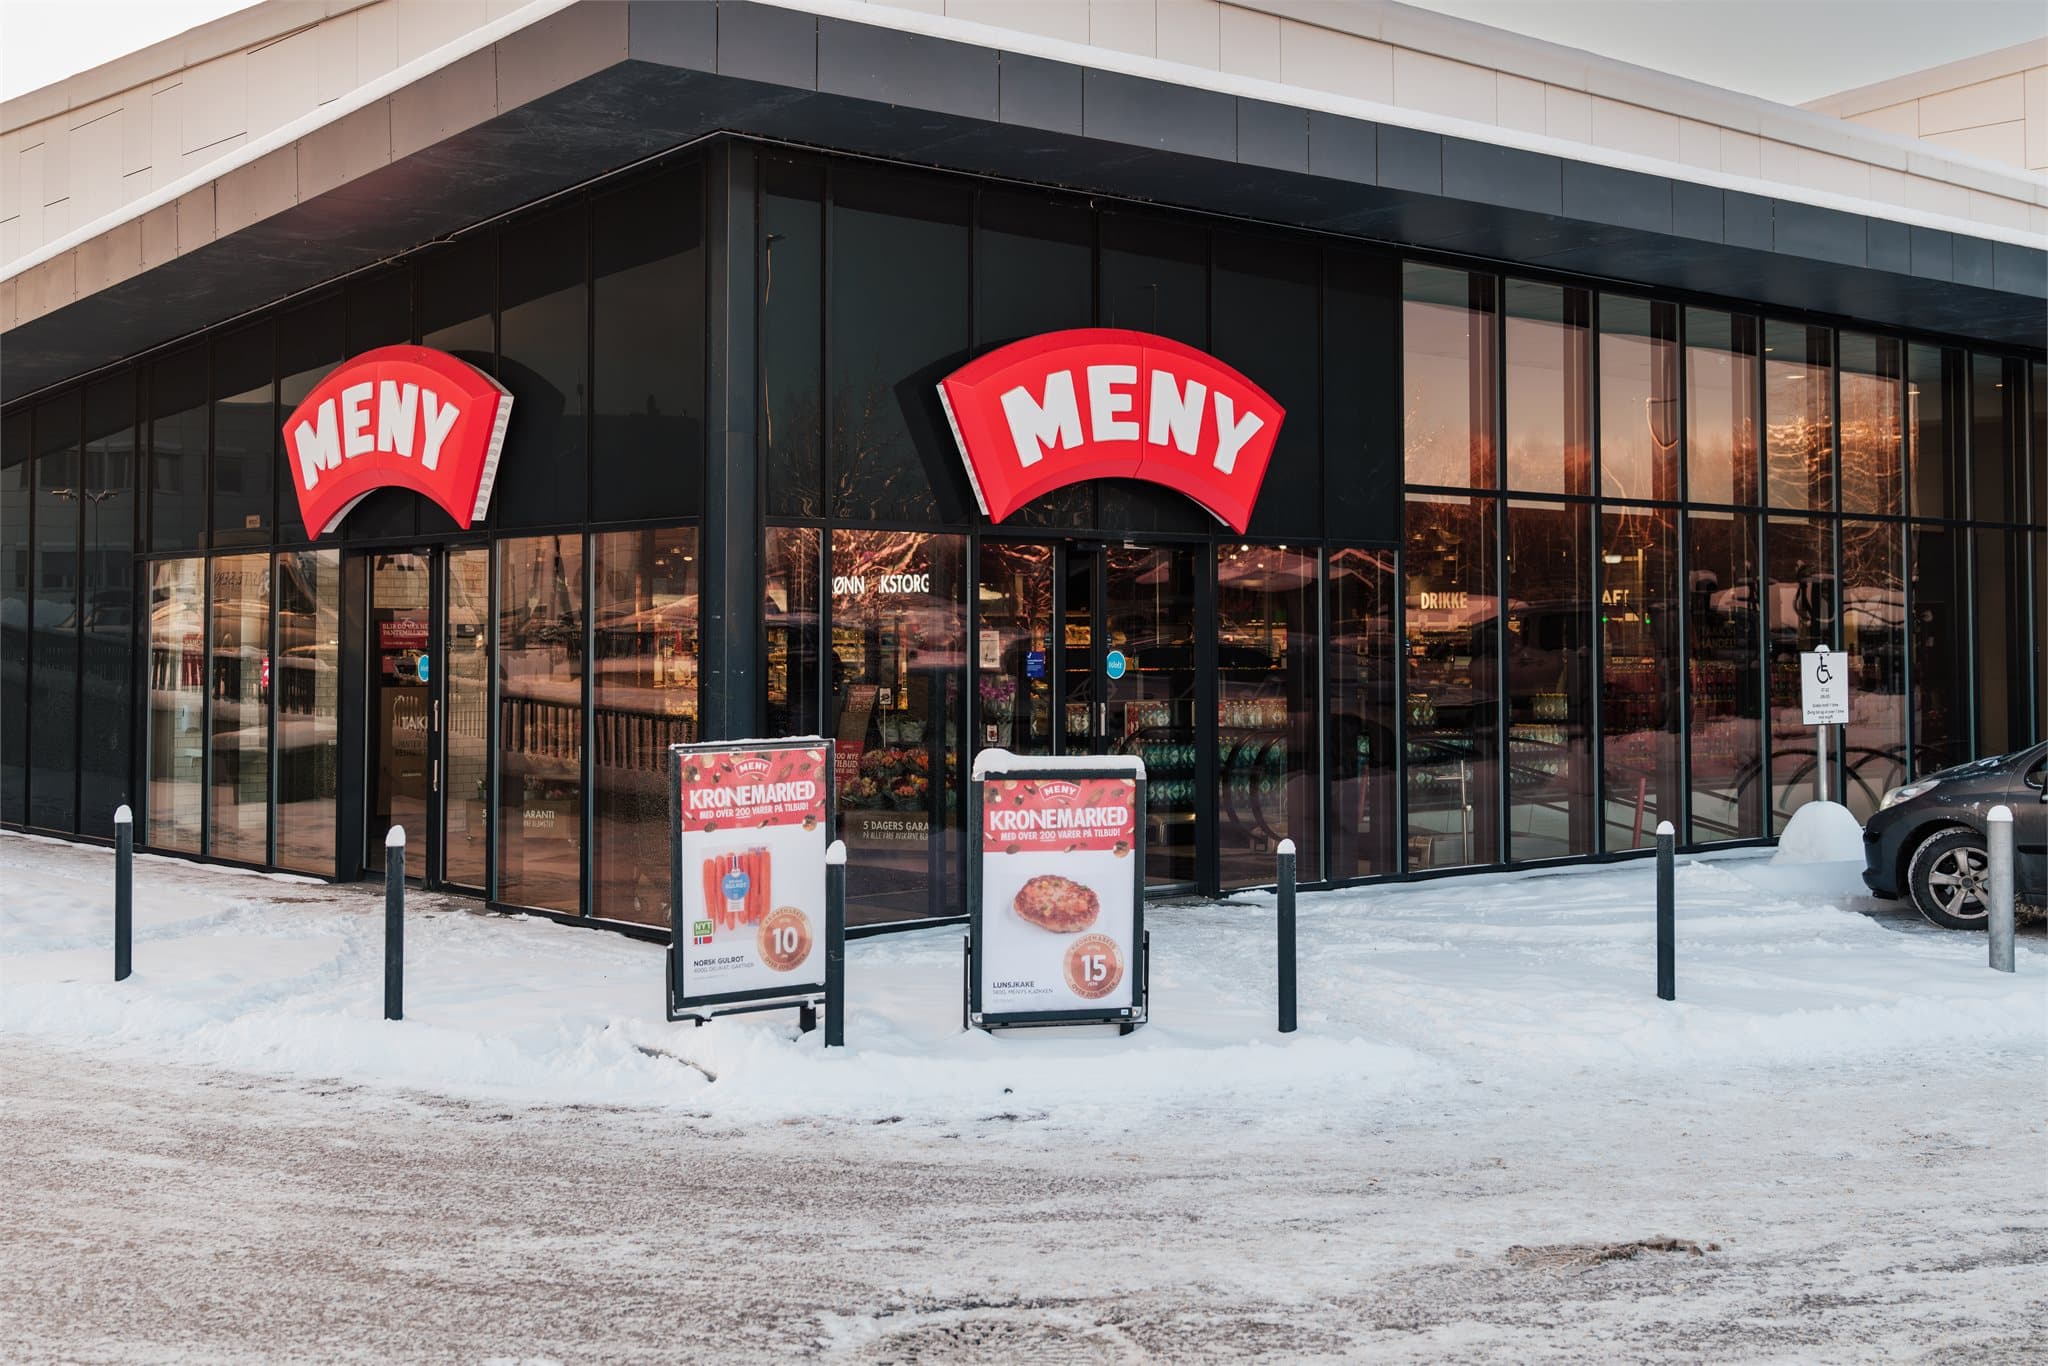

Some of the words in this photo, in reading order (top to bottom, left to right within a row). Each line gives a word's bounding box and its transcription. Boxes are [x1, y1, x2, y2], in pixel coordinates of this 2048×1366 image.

[1000, 365, 1265, 475] MENY
[294, 380, 460, 491] MENY
[1421, 592, 1467, 609] DRIKKE
[738, 761, 768, 774] MENY
[689, 780, 816, 810] KRONEMARKED
[1043, 784, 1076, 796] MENY
[700, 809, 714, 820] MED
[716, 808, 734, 818] OVER
[735, 807, 750, 817] 200
[752, 805, 773, 816] VARER
[774, 803, 783, 813] PÅ
[785, 802, 809, 813] TILBUD!
[990, 806, 1128, 831] KRONEMARKED
[863, 820, 869, 830] 5
[871, 821, 903, 830] DAGERS
[905, 821, 928, 831] GARA
[1001, 831, 1016, 841] MED
[1018, 831, 1037, 840] OVER
[1040, 830, 1056, 840] 200
[1058, 829, 1081, 839] VARER
[1083, 828, 1092, 838] PÅ
[1095, 828, 1121, 838] TILBUD!
[772, 926, 798, 955] 10
[694, 958, 716, 967] NORSK
[718, 955, 744, 965] GULROT
[1081, 954, 1107, 981] 15
